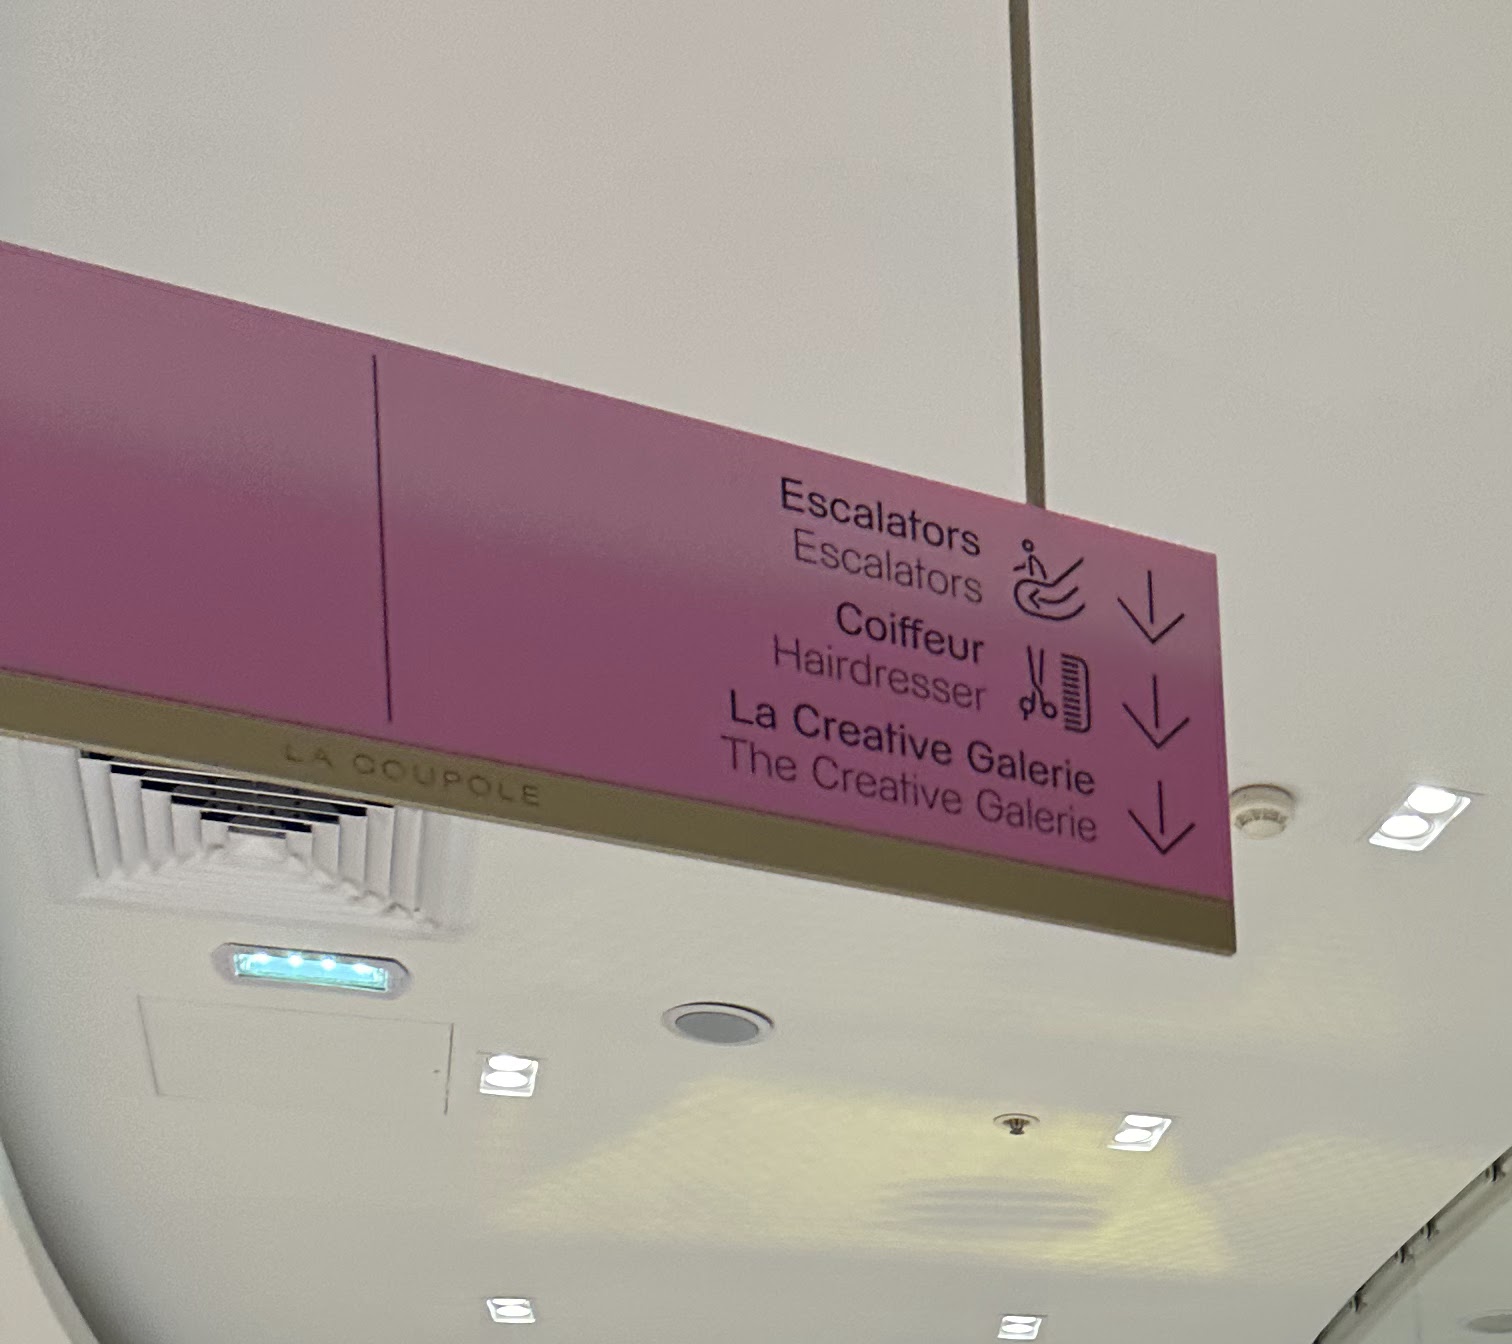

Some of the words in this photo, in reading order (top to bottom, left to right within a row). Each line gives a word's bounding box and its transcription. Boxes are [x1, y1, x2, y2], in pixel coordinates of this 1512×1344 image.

[781, 476, 981, 556] Escalators
[793, 528, 983, 604] Escalators
[835, 601, 985, 663] Coiffeur
[774, 634, 986, 711] Hairdresser
[284, 744, 334, 768] LA
[352, 753, 541, 807] COUPOLE
[729, 688, 777, 729] La
[793, 702, 953, 765] Creative
[966, 740, 1096, 795] Galerie
[721, 734, 797, 782] The
[812, 754, 963, 815] Creative
[976, 788, 1097, 842] Galerie
